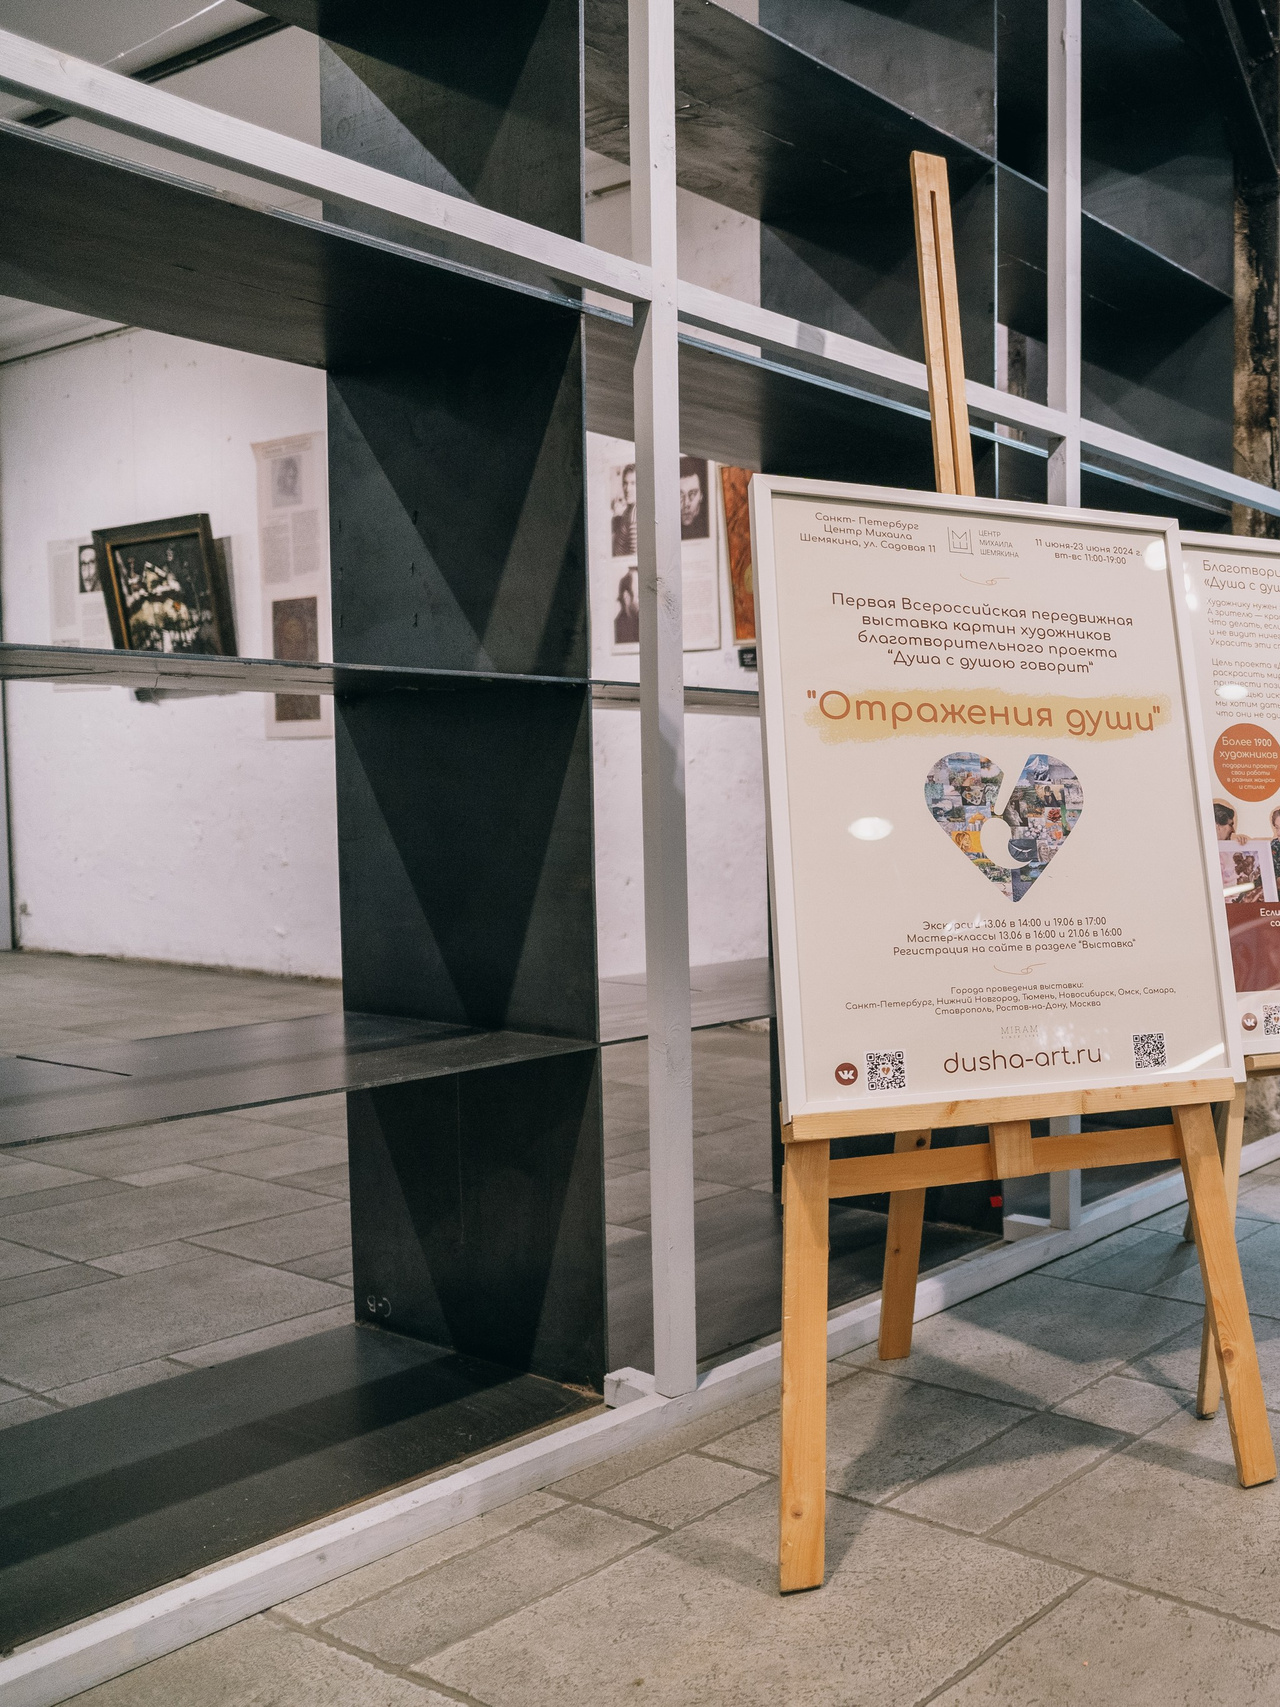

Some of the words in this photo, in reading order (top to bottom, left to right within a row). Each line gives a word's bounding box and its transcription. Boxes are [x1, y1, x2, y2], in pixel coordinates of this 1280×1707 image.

[814, 511, 855, 523] Санкт-
[858, 515, 919, 531] Петербург
[823, 523, 862, 537] Центр
[864, 527, 912, 540] Михаила
[977, 529, 1001, 537] ЦЕНТР
[799, 532, 861, 547] Шемякина,
[862, 540, 877, 549] ул.
[879, 539, 926, 552] Садовая
[927, 544, 936, 553] 11
[978, 538, 1013, 548] МИХАИЛА
[1034, 537, 1042, 546] 11
[1044, 541, 1084, 551] июня-23
[1085, 545, 1110, 553] июня
[1112, 545, 1133, 555] 2024
[979, 548, 1019, 558] ШЕМЯКИНА
[1053, 551, 1082, 560] вт-вс
[1083, 552, 1126, 565] 11:00-19:00
[1203, 575, 1246, 591] «Душа
[1248, 581, 1256, 591] с
[831, 591, 896, 610] Первая
[901, 596, 1026, 618] Всероссийская
[1031, 609, 1133, 626] передвижная
[1206, 606, 1213, 615] А
[1214, 608, 1253, 618] зрителю
[1252, 602, 1277, 611] нужен
[861, 615, 948, 630] выставка
[952, 621, 1016, 635] картин
[1019, 625, 1111, 641] художников
[1207, 616, 1227, 626] Что
[1228, 620, 1262, 630] делать,
[857, 629, 1044, 653] благотворительного
[1048, 644, 1117, 658] проекта
[945, 655, 954, 666] с
[959, 656, 1015, 670] душою
[806, 688, 1053, 730] "Отражения
[1065, 704, 1160, 737] души"
[1221, 735, 1252, 746] Более
[1253, 737, 1272, 747] 1900
[1218, 750, 1278, 760] художников
[1259, 907, 1280, 917] Если
[984, 918, 1006, 928] 13.06
[1017, 917, 1041, 927] 14:00
[1053, 917, 1074, 926] 19.06
[1085, 915, 1106, 925] 17:00
[906, 933, 996, 944] Мастер-классы
[998, 930, 1022, 940] 13.06
[1024, 931, 1031, 939] в
[1032, 929, 1056, 938] 16:00
[1067, 927, 1090, 938] 21.06
[1100, 926, 1122, 936] 16:00
[892, 945, 969, 956] Регистрация
[971, 945, 985, 953] на
[987, 942, 1023, 952] сайте
[1025, 943, 1032, 951] в
[1034, 942, 1077, 952] разделе
[950, 985, 984, 995] Города
[985, 984, 1037, 994] проведения
[1039, 982, 1083, 990] выставки:
[844, 997, 934, 1010] Санкт-Петербург,
[935, 995, 972, 1005] Нижний
[974, 994, 1020, 1003] Новгород,
[1021, 992, 1057, 1000] Тюмень,
[1058, 989, 1116, 999] Новосибирск,
[1116, 987, 1141, 996] Омск,
[1142, 986, 1176, 995] Самара,
[934, 1006, 994, 1015] Ставрополь,
[995, 1001, 1068, 1011] Ростов-на-Дону,
[1068, 999, 1101, 1007] Москва
[943, 1045, 1101, 1073] dusha-art.ru
